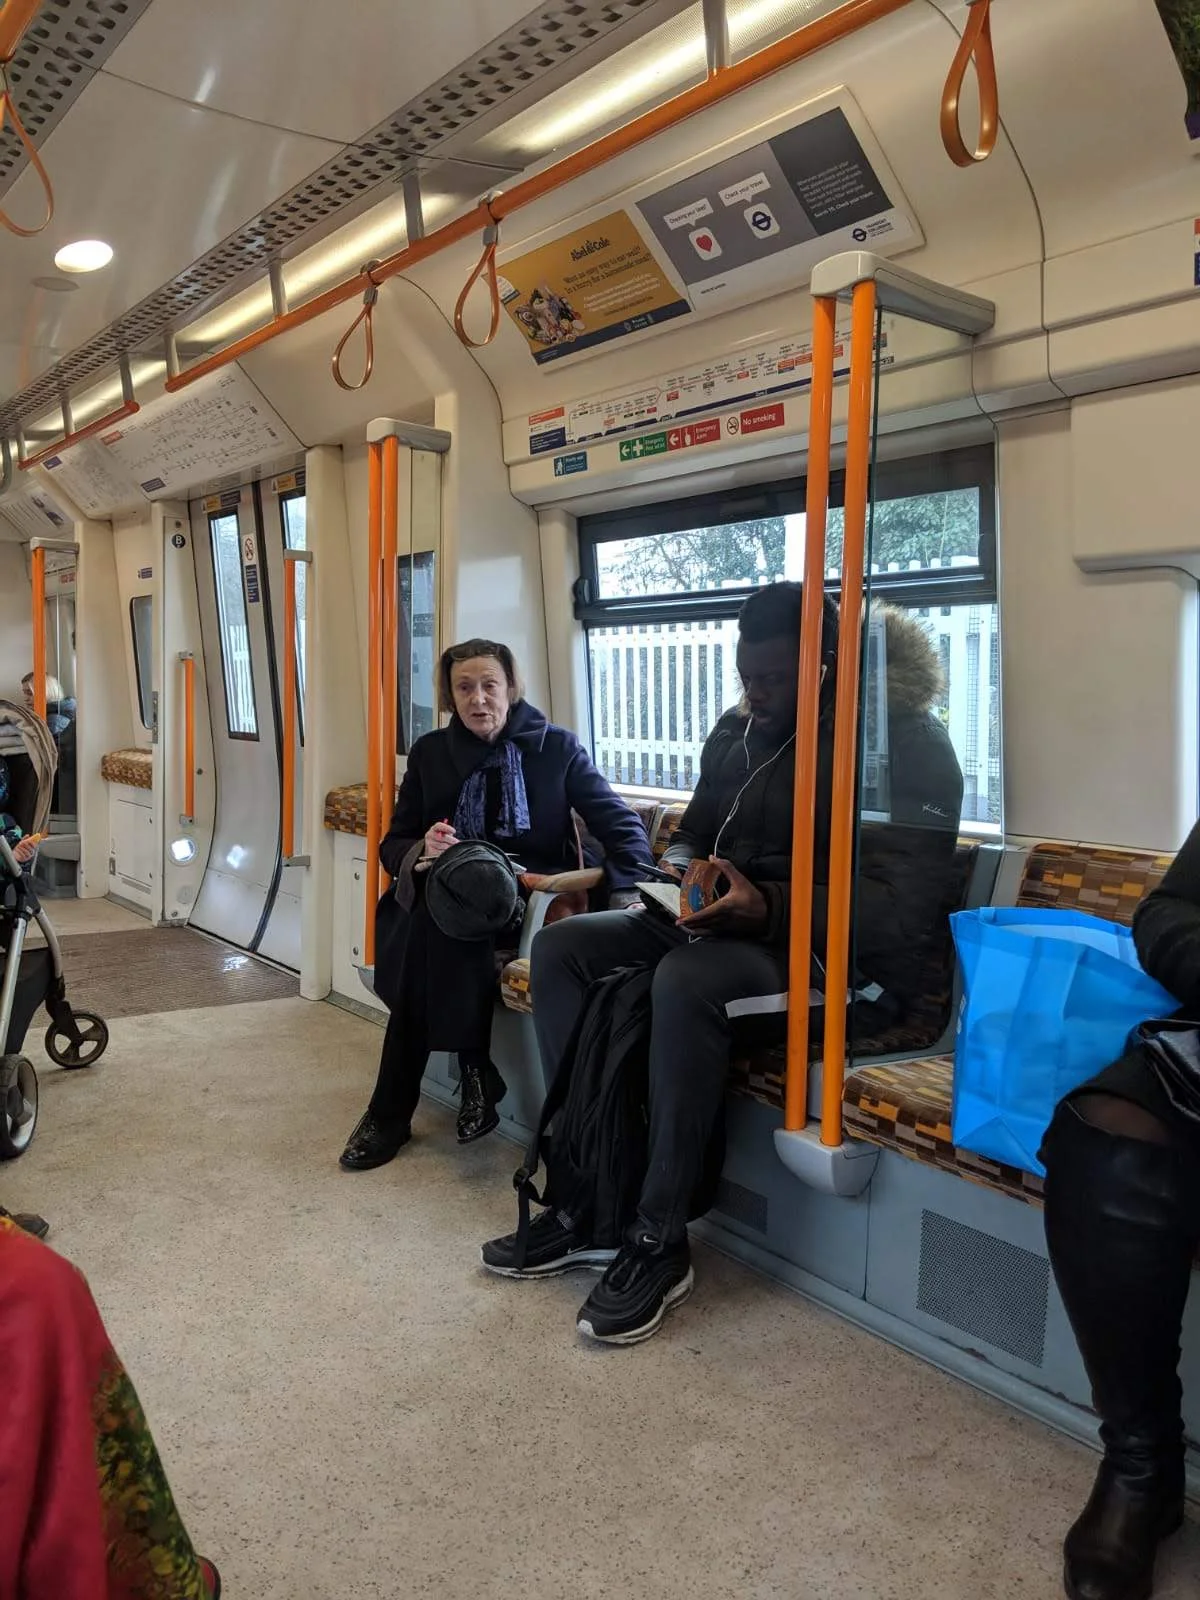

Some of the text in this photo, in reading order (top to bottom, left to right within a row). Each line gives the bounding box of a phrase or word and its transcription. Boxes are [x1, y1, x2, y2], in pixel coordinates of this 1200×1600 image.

[571, 245, 588, 261] Abel
[592, 236, 610, 251] Cole
[743, 412, 776, 425] No smoking
[175, 535, 183, 545] B
